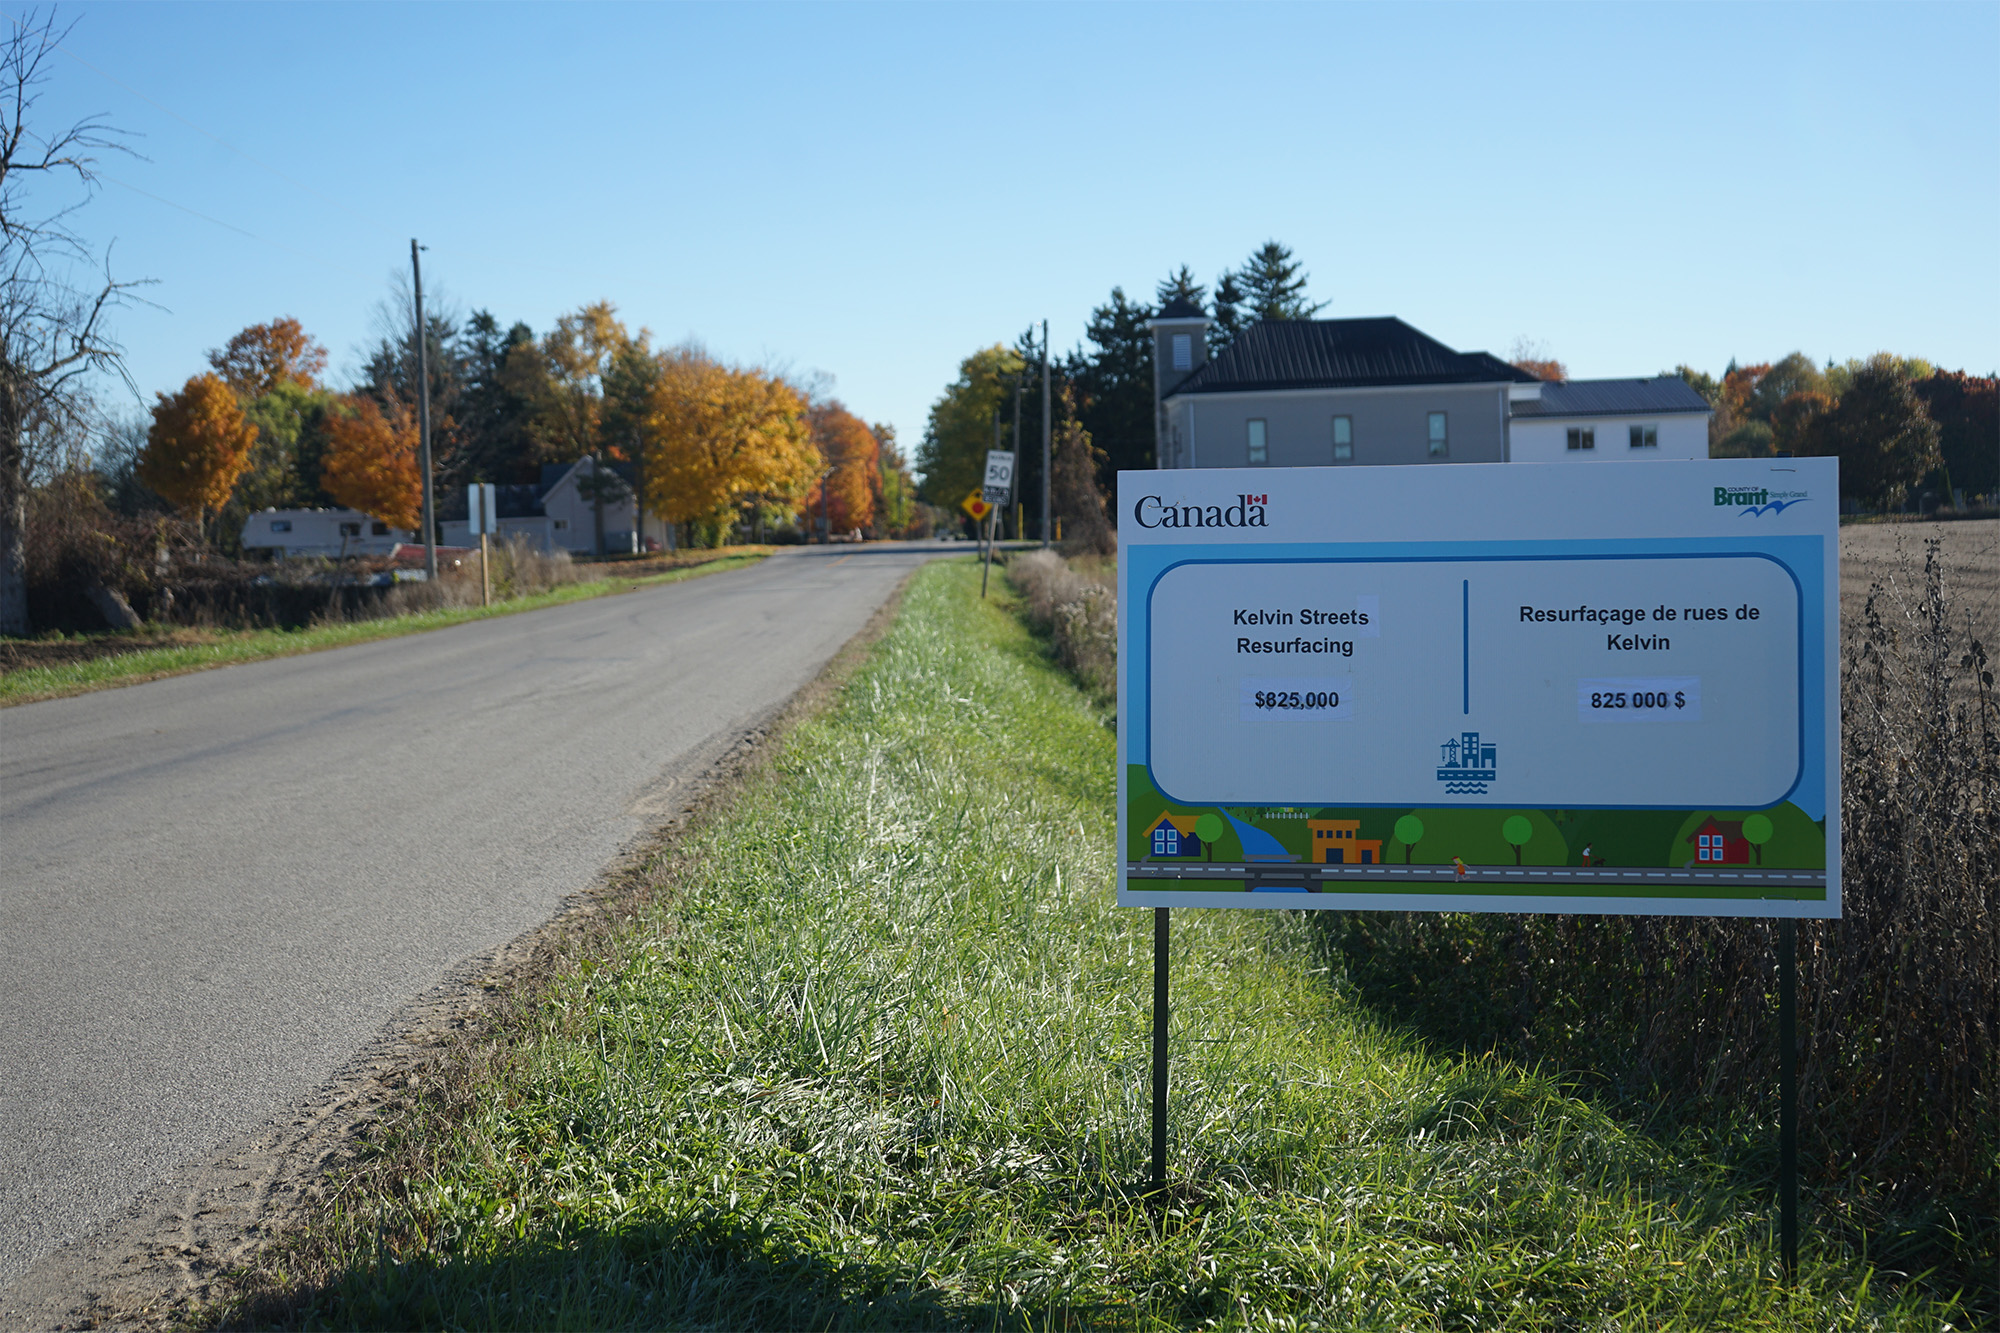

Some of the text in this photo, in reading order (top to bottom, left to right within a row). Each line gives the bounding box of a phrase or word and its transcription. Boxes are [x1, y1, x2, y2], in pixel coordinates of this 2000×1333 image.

[989, 465, 1010, 481] 50
[1714, 487, 1768, 506] Brant
[1134, 494, 1269, 529] Canada
[1233, 609, 1369, 625] Kelvin Streets
[1520, 604, 1760, 626] Resurfaçage de rues de
[1237, 637, 1353, 657] Resurfacing
[1607, 634, 1670, 651] Kelvin
[1255, 691, 1339, 709] $825,000
[1591, 691, 1686, 710] 825 000 $
